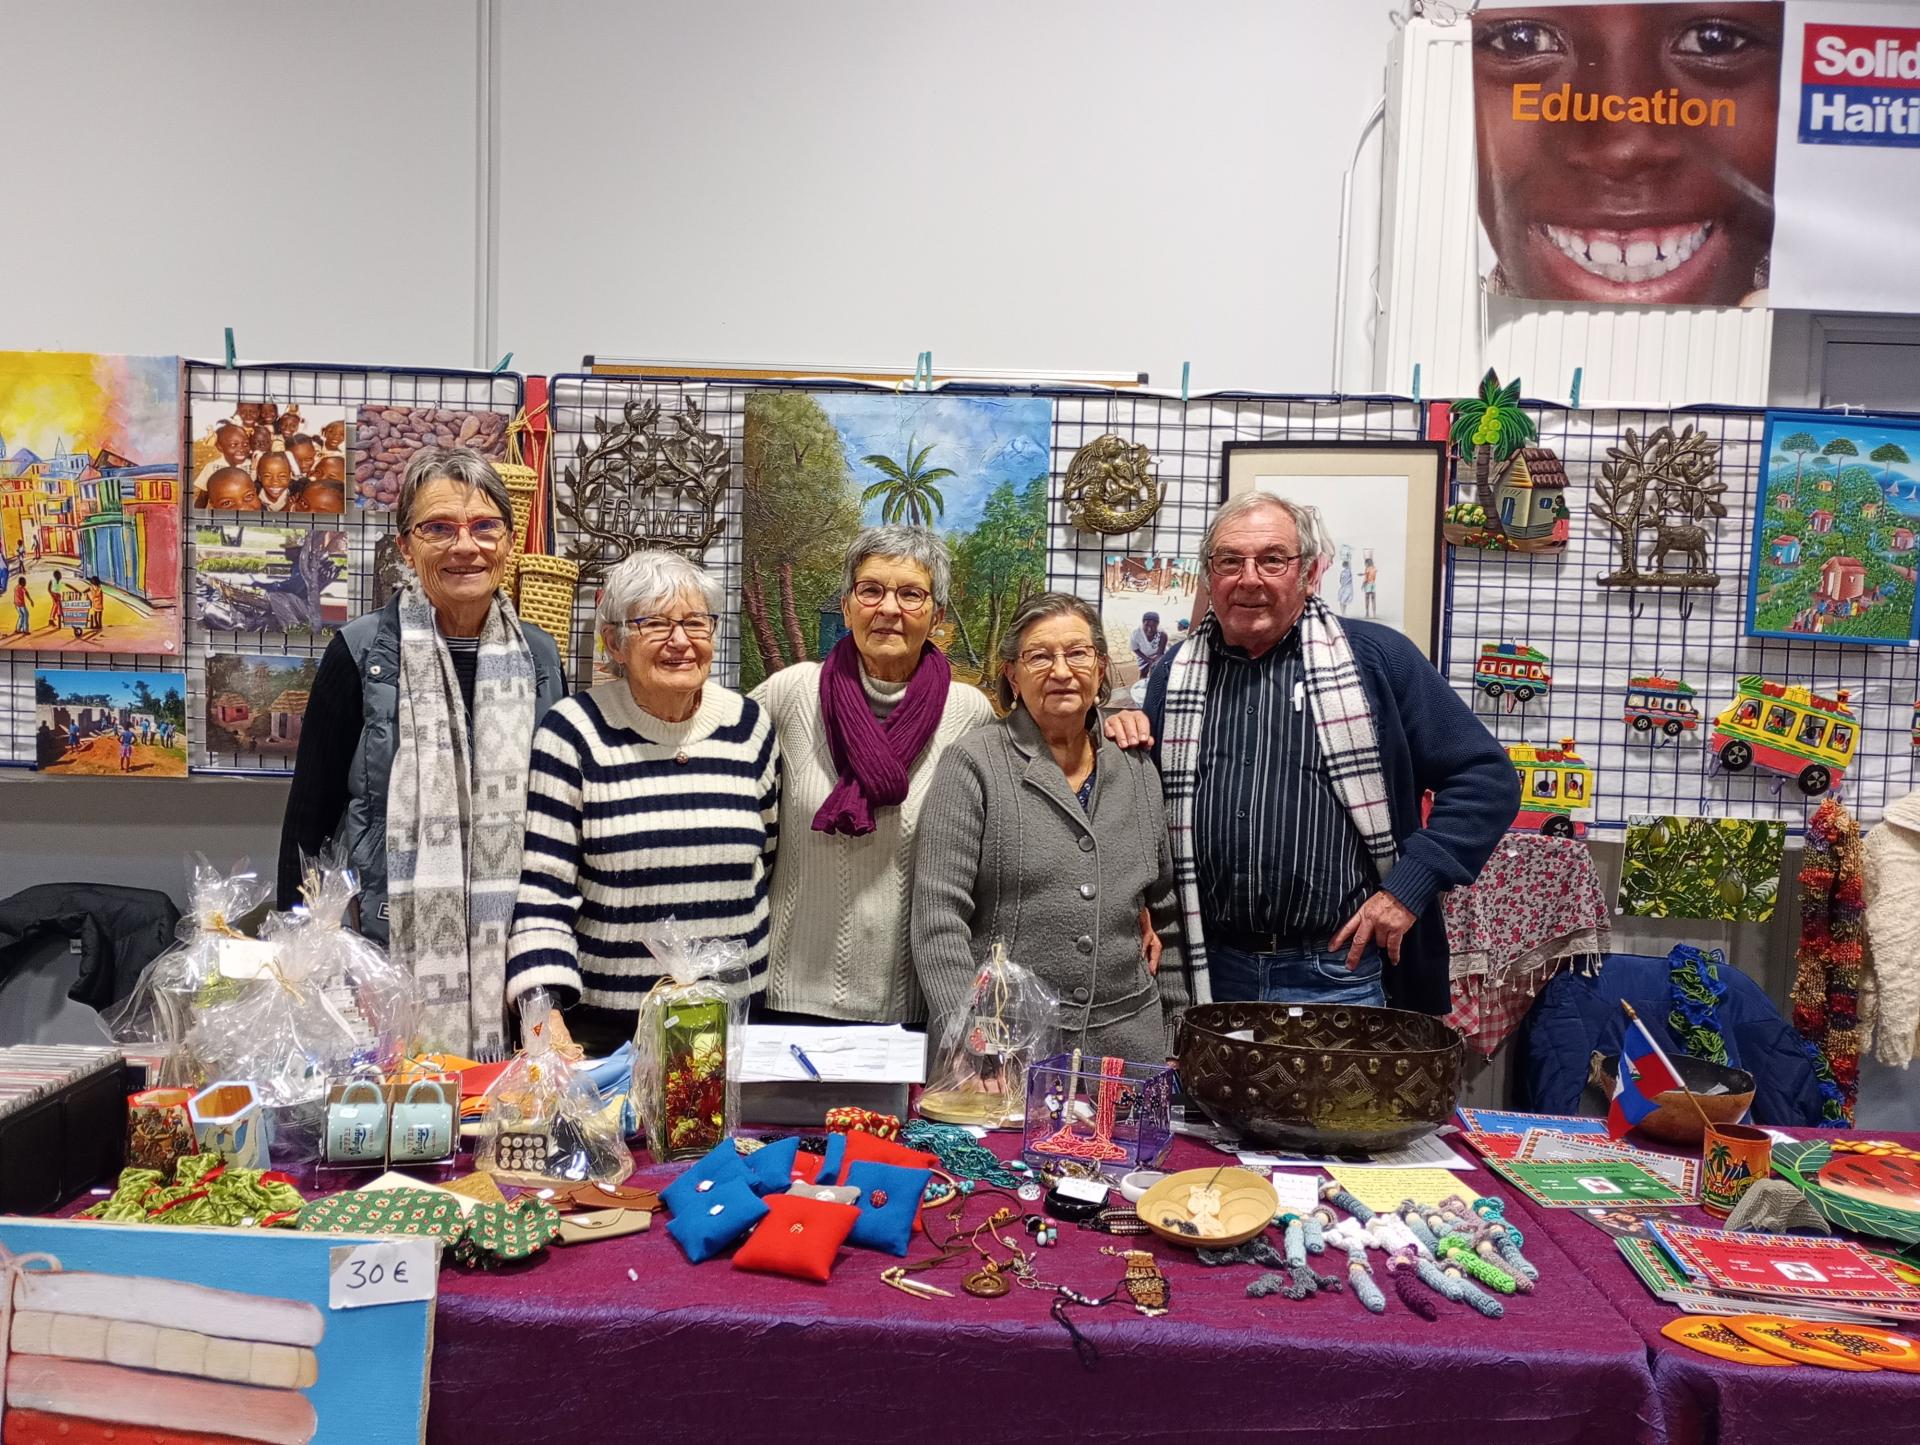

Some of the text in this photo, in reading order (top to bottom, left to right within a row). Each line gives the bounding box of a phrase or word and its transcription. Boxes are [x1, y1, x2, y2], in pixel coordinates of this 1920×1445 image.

[1511, 83, 1737, 127] Education
[1810, 92, 1920, 135] Haïti
[598, 498, 702, 537] FRANCE
